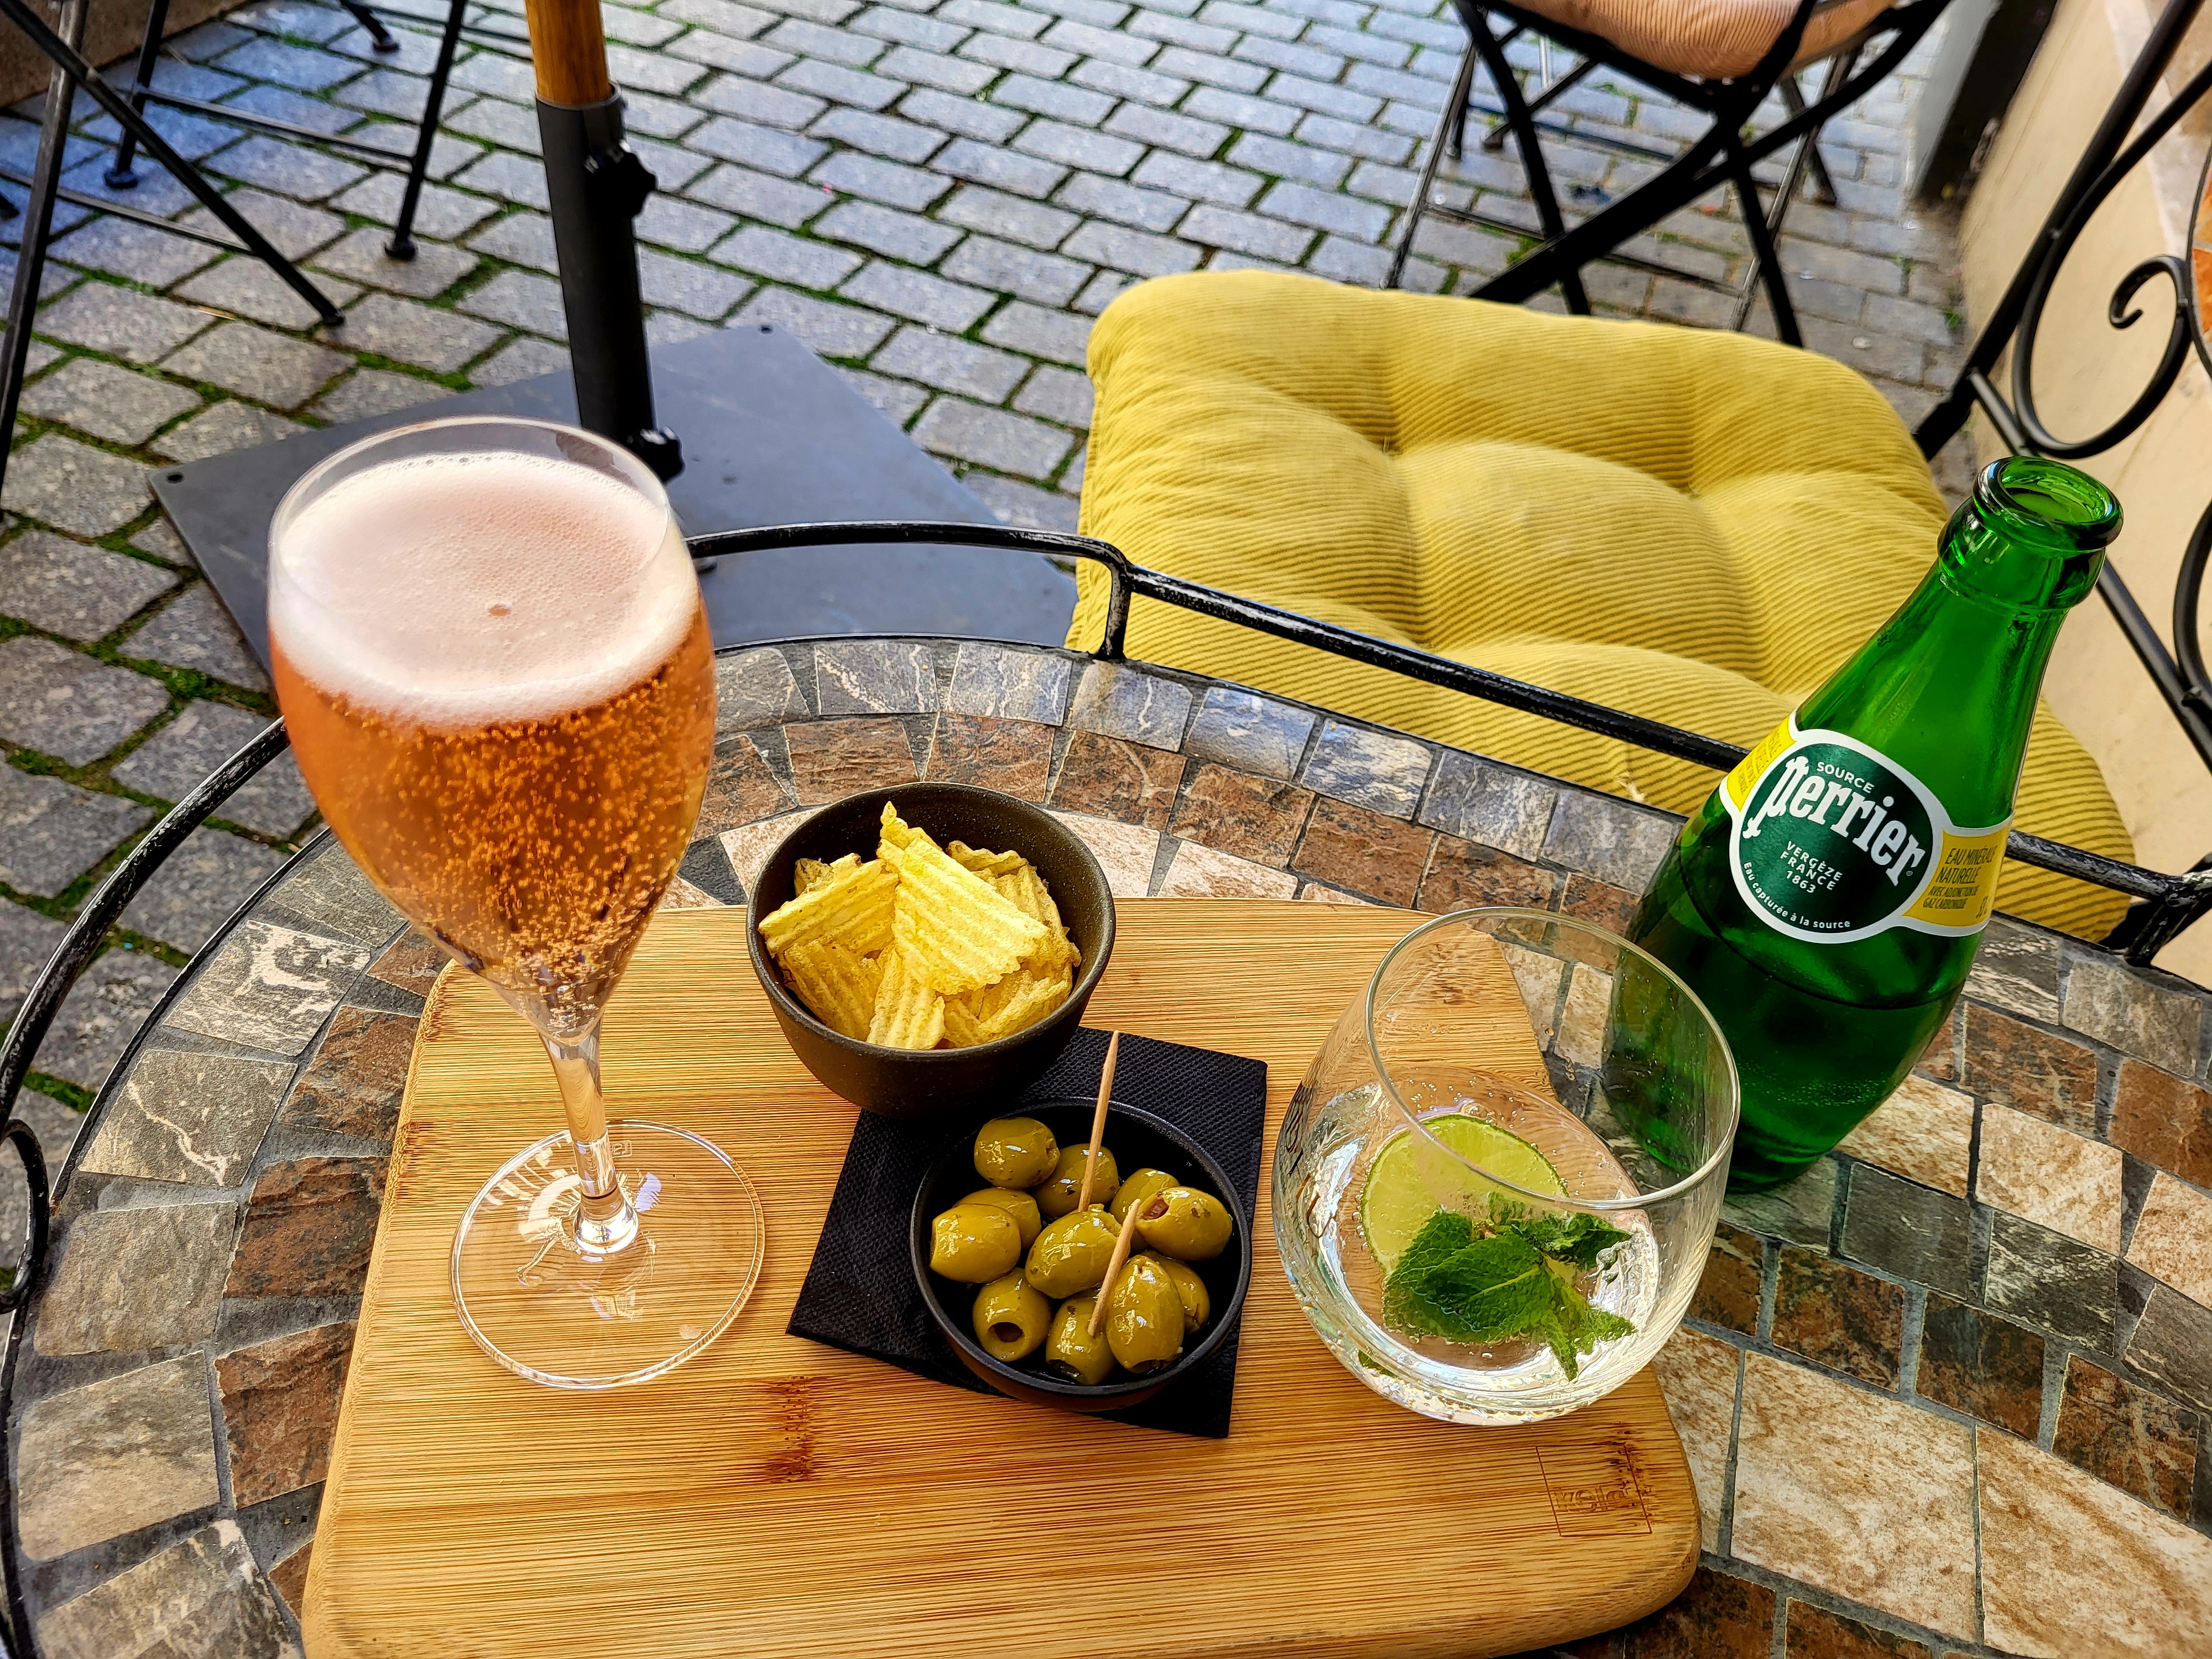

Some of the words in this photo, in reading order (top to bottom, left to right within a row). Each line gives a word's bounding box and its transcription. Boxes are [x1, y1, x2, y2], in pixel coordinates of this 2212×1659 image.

[1816, 761, 1875, 794] SOURCE
[1780, 851, 1836, 890] FRANCE
[1787, 840, 1843, 881] VERGÈZE
[1744, 862, 1755, 881] Eau
[1752, 883, 1788, 917] capturée
[1799, 916, 1809, 926] la
[1813, 921, 1850, 929] source
[1786, 870, 1816, 893] 1863
